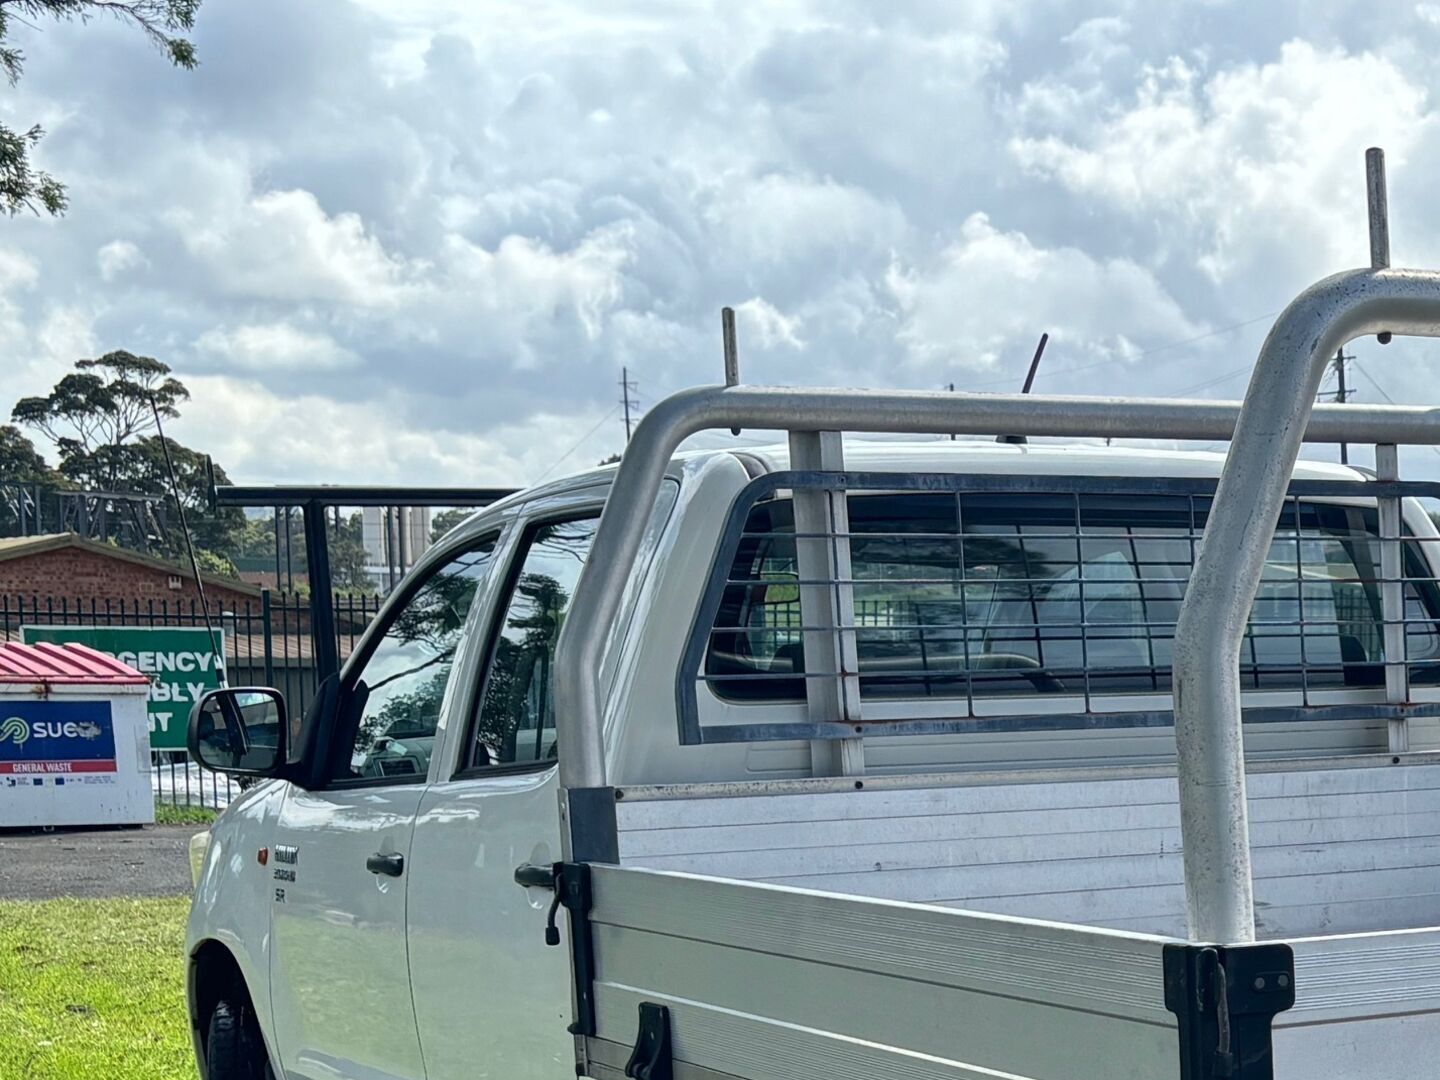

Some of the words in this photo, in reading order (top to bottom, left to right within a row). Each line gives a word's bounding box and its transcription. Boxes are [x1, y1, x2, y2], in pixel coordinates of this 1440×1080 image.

[101, 651, 213, 672] GENCY
[12, 762, 45, 774] GENERAL
[46, 762, 73, 773] WASTE
